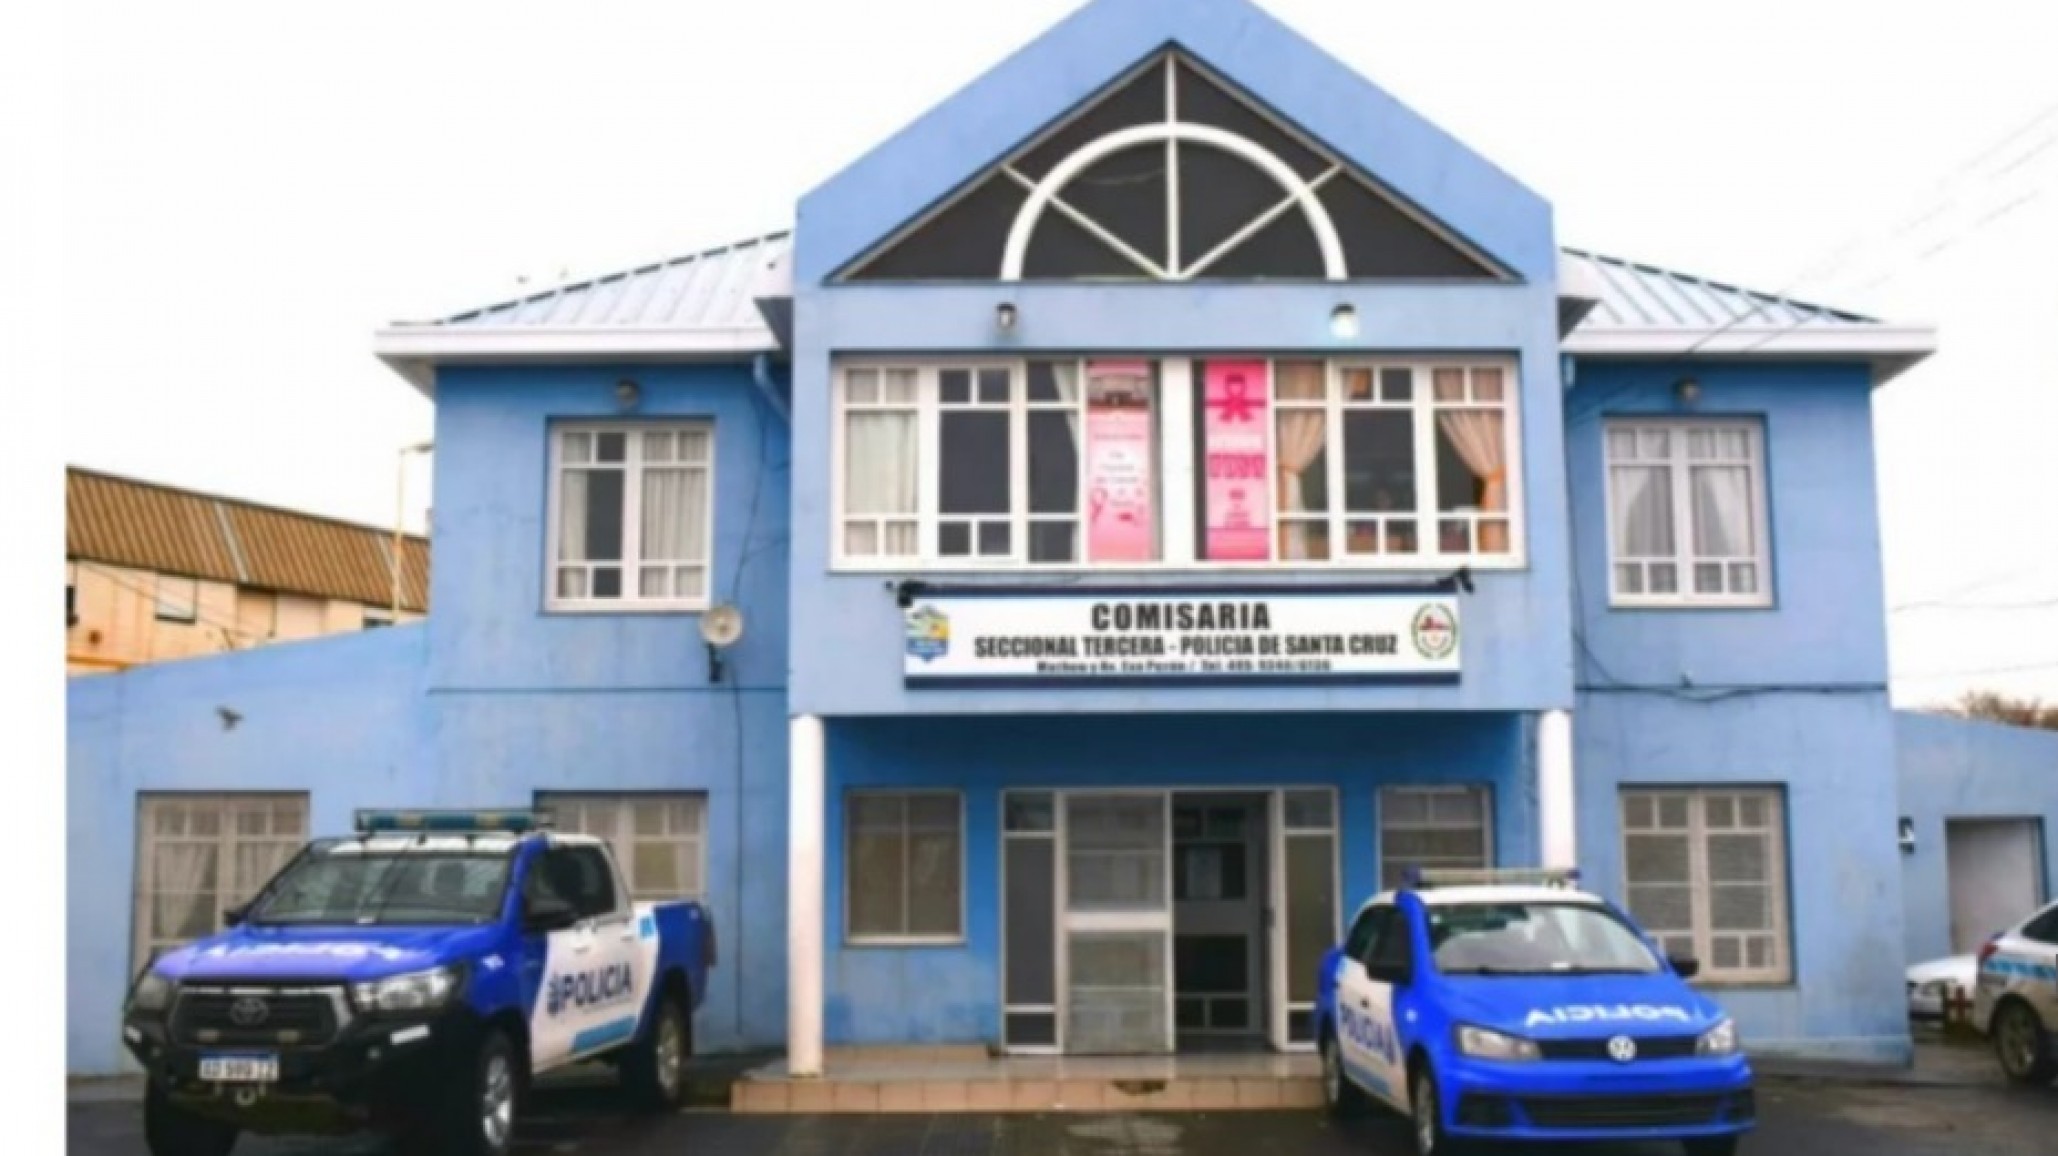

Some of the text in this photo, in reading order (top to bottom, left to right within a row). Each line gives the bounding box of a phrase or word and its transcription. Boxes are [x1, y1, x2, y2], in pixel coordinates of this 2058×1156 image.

[1091, 602, 1271, 631] COMISARIA
[974, 635, 1078, 658] SECCIONAL
[1083, 635, 1165, 657] TERCERA
[1180, 634, 1254, 656] POLICIA
[1258, 634, 1279, 655] DE
[1284, 634, 1345, 655] SANTA
[1348, 633, 1398, 655] CRUZ
[563, 963, 632, 1010] POLICIA
[1339, 1001, 1397, 1065] POLICIA
